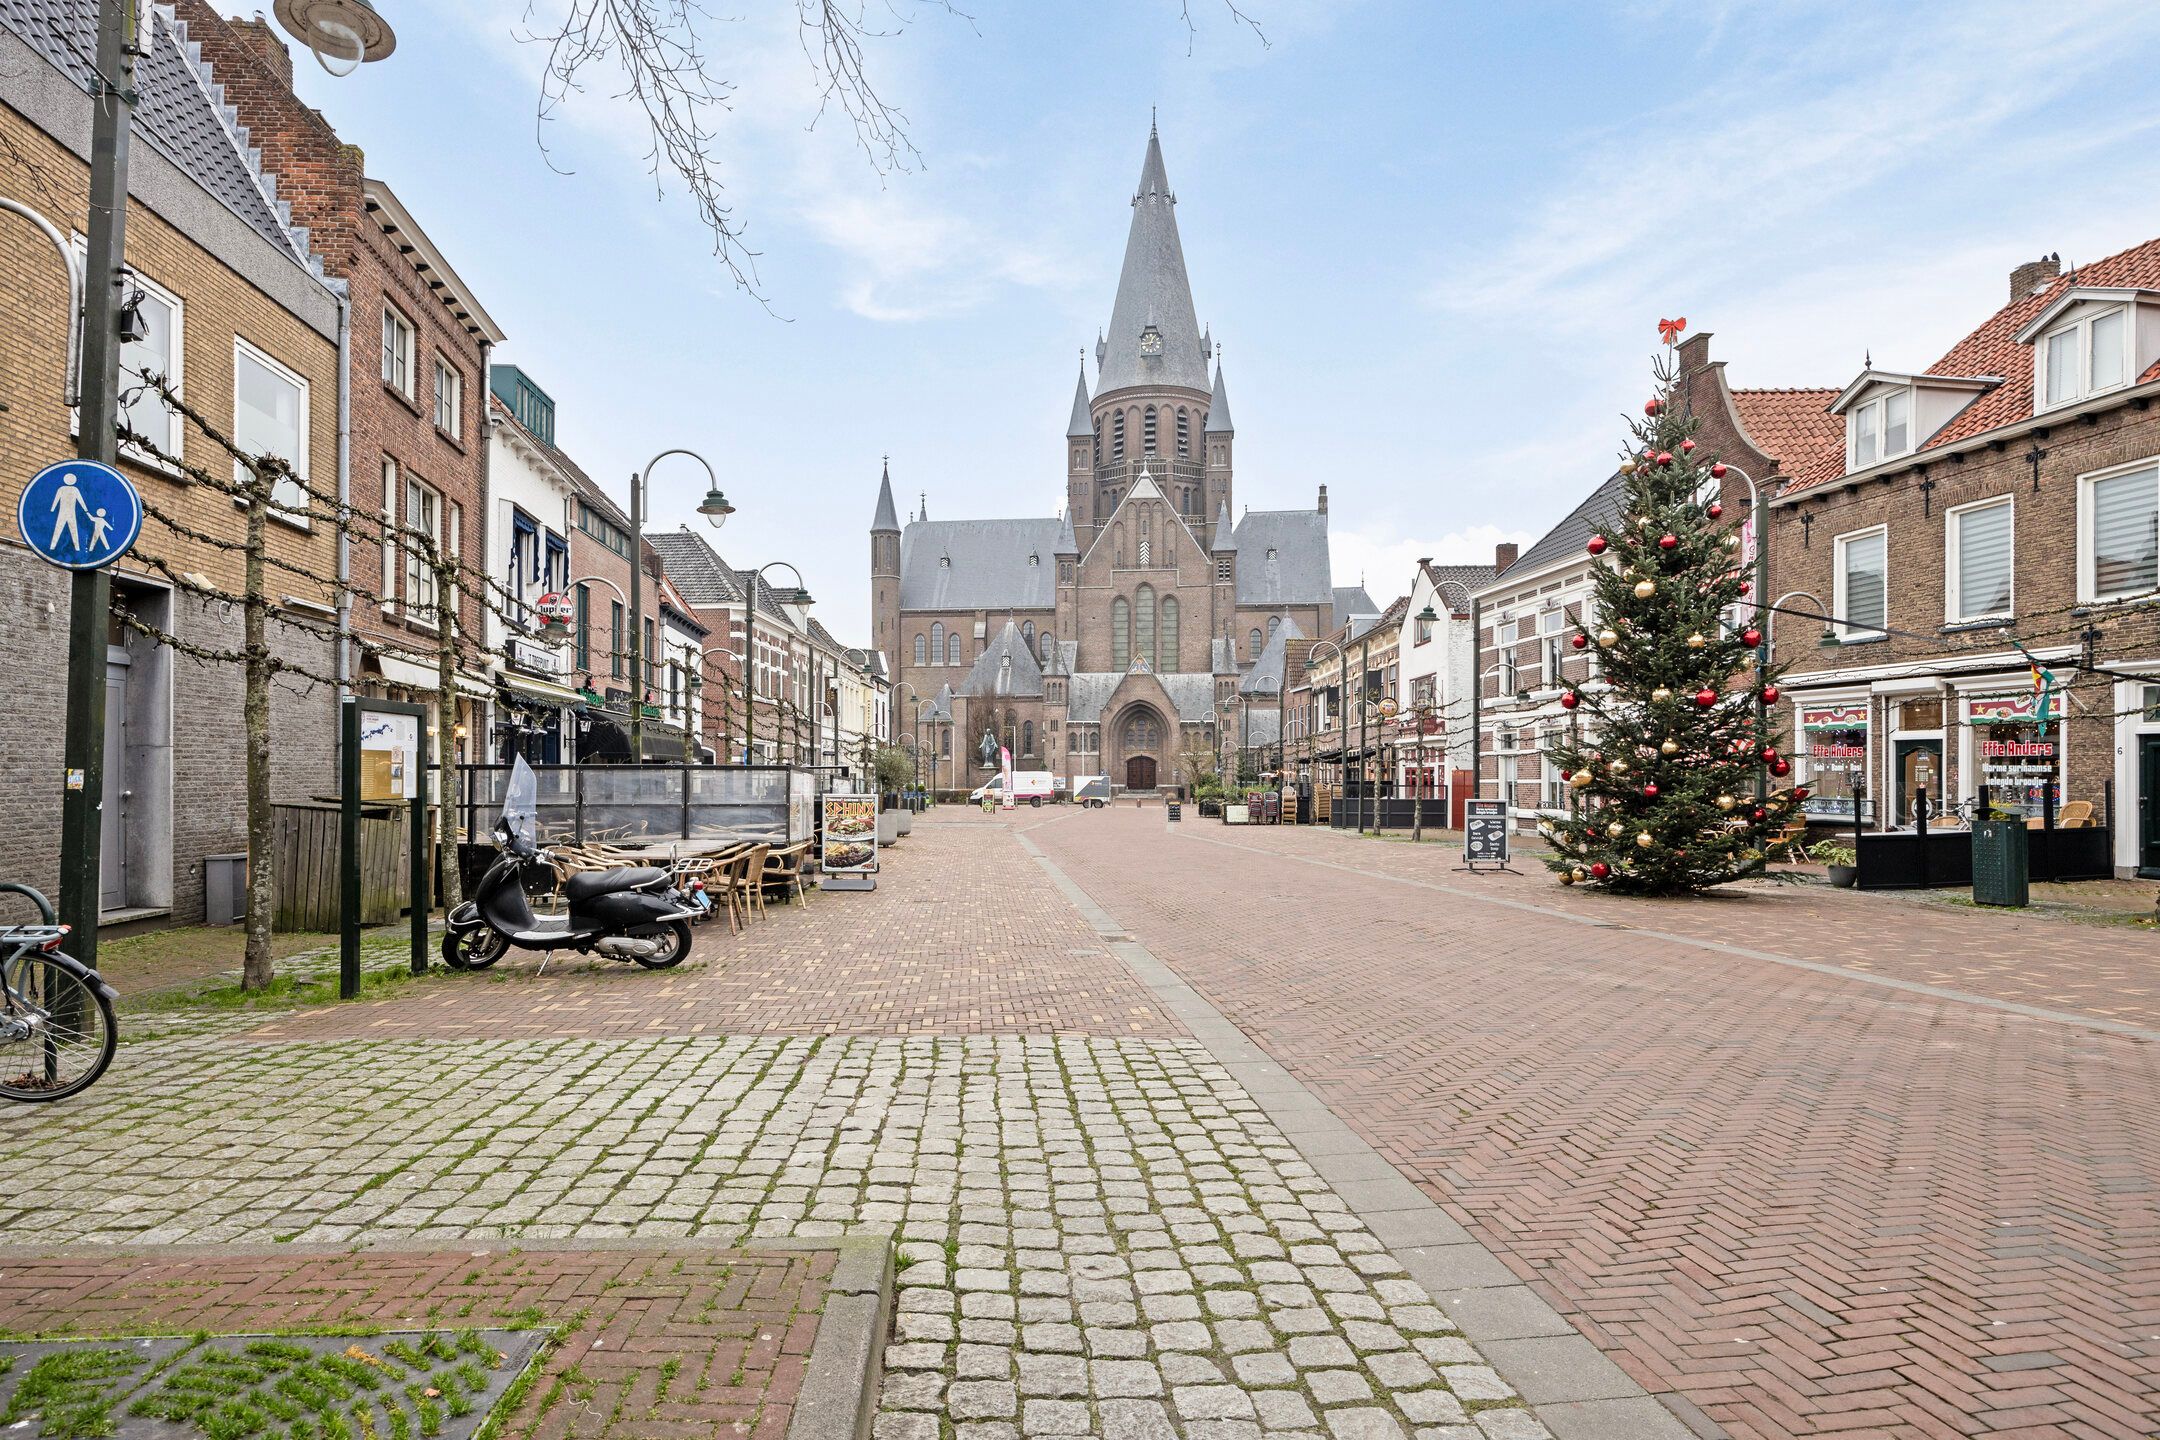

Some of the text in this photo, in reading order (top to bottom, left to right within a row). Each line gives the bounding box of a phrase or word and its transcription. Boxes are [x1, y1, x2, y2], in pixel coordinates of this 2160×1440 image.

[539, 605, 572, 615] Juper
[1813, 744, 1864, 759] Effe Anders
[1982, 739, 2053, 756] Effe Anders
[2117, 746, 2123, 755] 6
[1982, 763, 2007, 773] Warme
[825, 802, 875, 816] SPHINX
